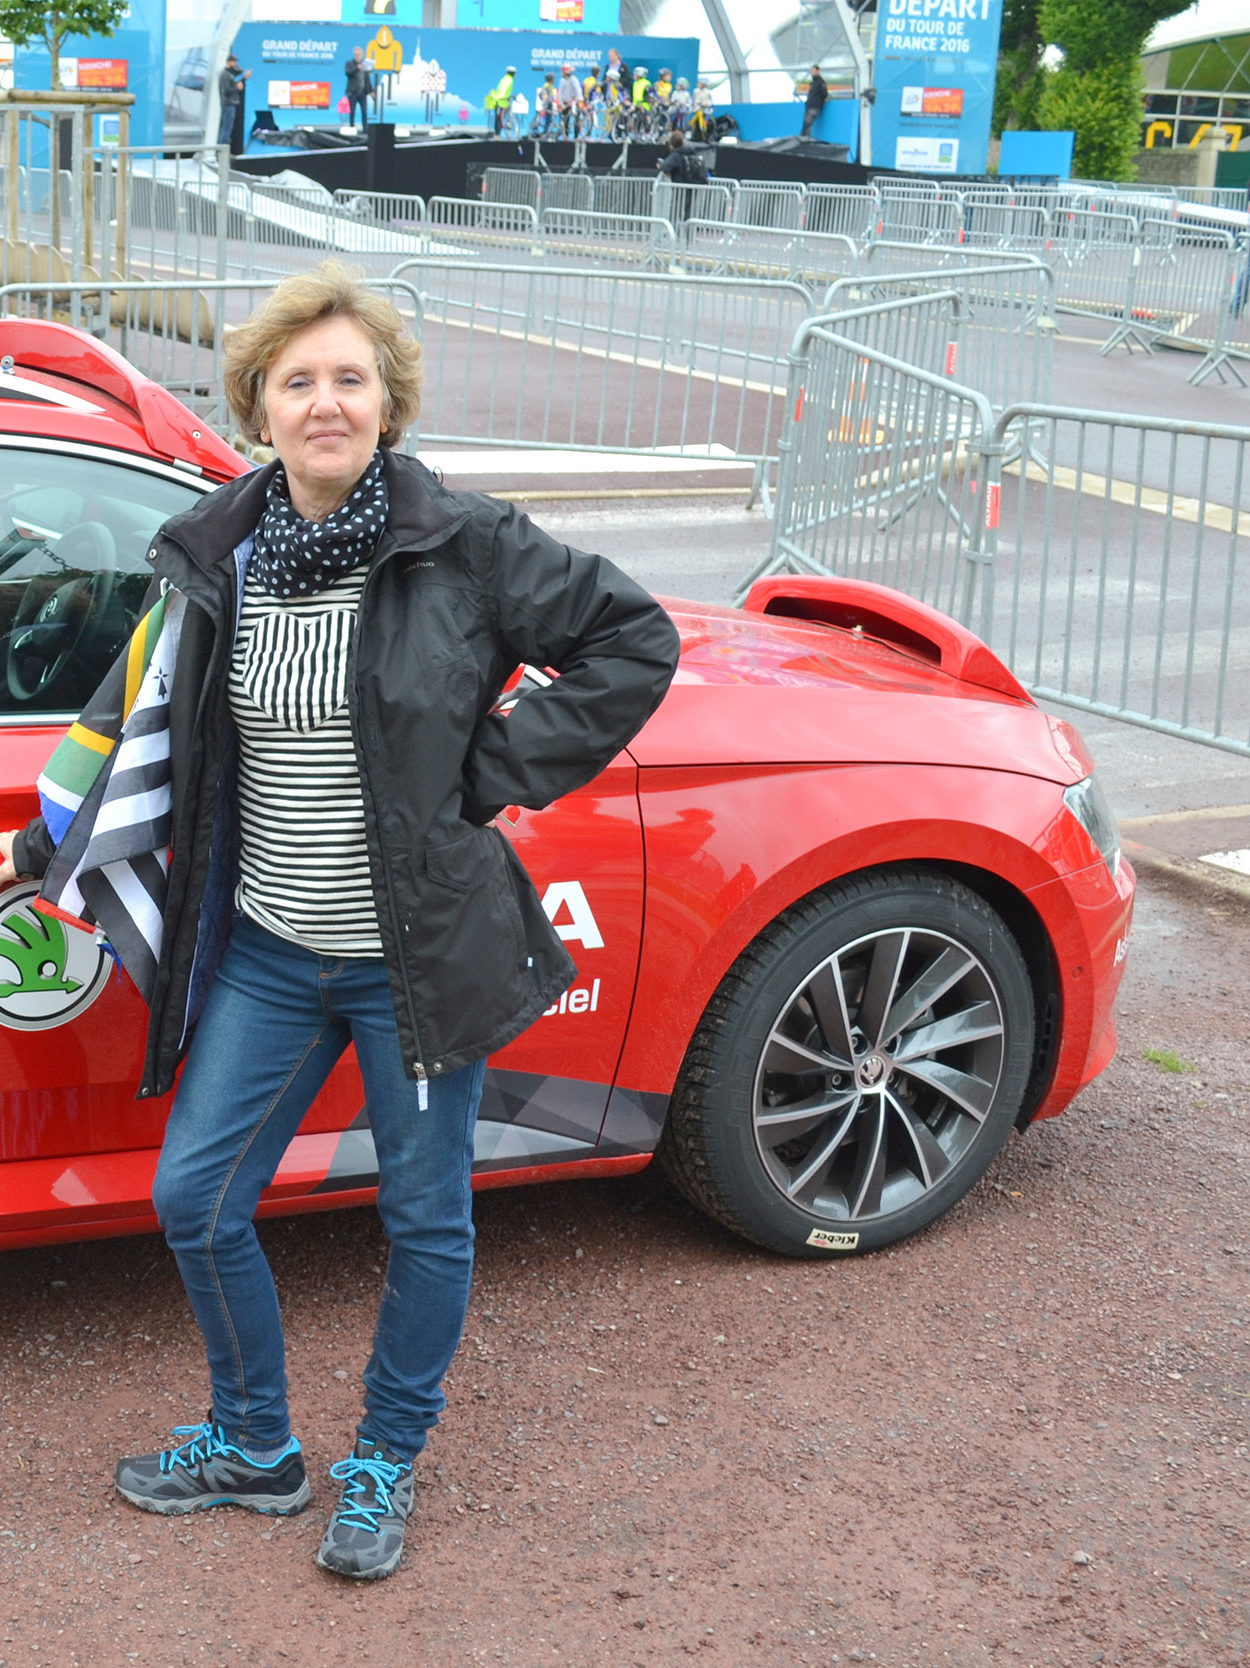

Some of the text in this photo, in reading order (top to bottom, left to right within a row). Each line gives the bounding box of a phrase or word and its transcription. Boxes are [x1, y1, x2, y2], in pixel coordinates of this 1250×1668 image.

[886, 18, 965, 36] DU TOUR DE
[262, 38, 338, 53] GRAND DÉPART
[885, 35, 970, 53] FRANCE 2016
[531, 47, 602, 60] GRAND DÉPART
[813, 1232, 856, 1244] Kleber
